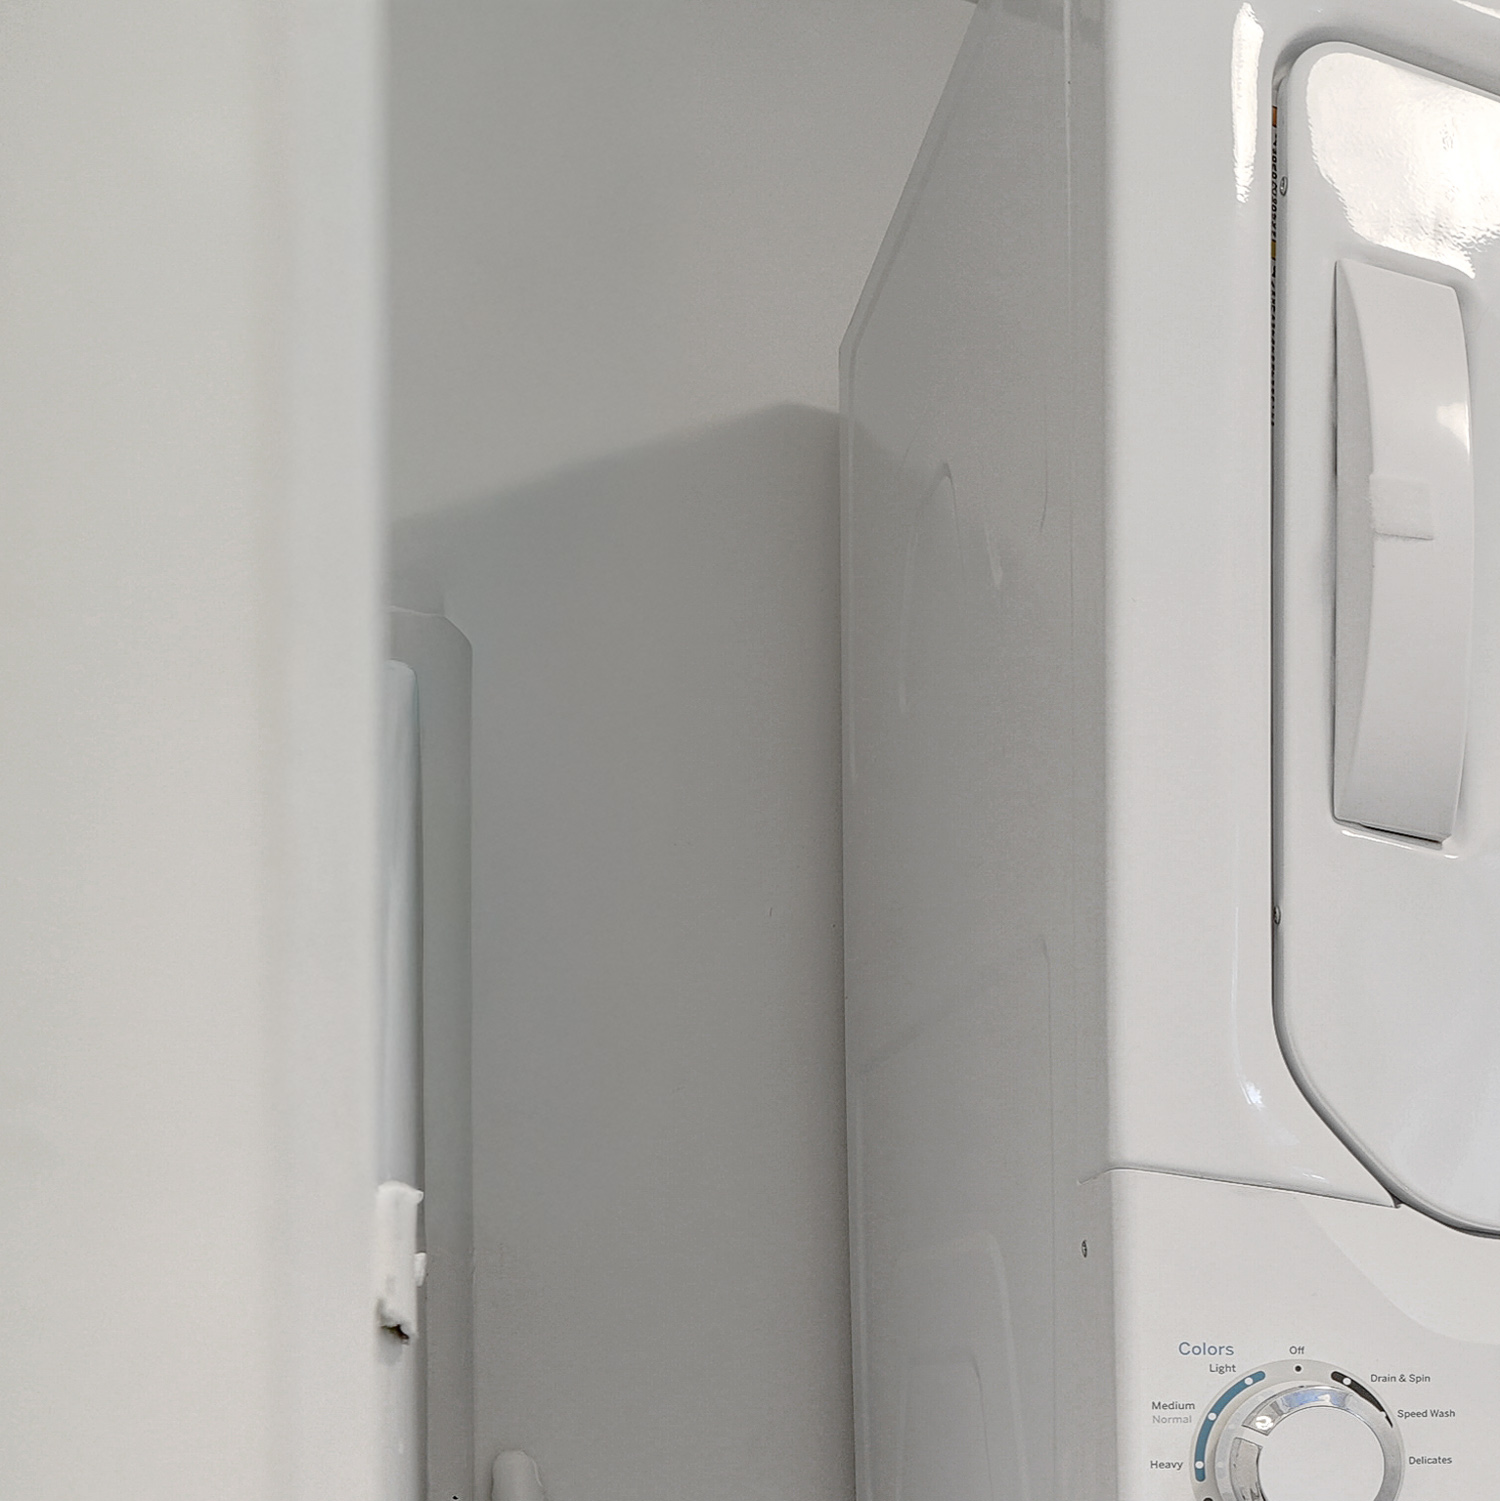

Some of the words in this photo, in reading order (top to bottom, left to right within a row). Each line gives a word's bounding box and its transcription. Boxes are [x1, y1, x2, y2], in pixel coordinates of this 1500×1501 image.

[1178, 1341, 1235, 1357] Colors
[1289, 1346, 1305, 1355] Off
[1209, 1363, 1236, 1374] Light
[1370, 1374, 1396, 1383] Drain
[1398, 1374, 1406, 1383] &
[1409, 1374, 1431, 1384] Spin
[1151, 1400, 1195, 1411] Medium
[1152, 1415, 1192, 1424] Normal
[1397, 1409, 1426, 1420] Speed
[1428, 1408, 1456, 1418] Wash
[1150, 1460, 1184, 1471] Heavy
[1408, 1455, 1453, 1465] Delicates
